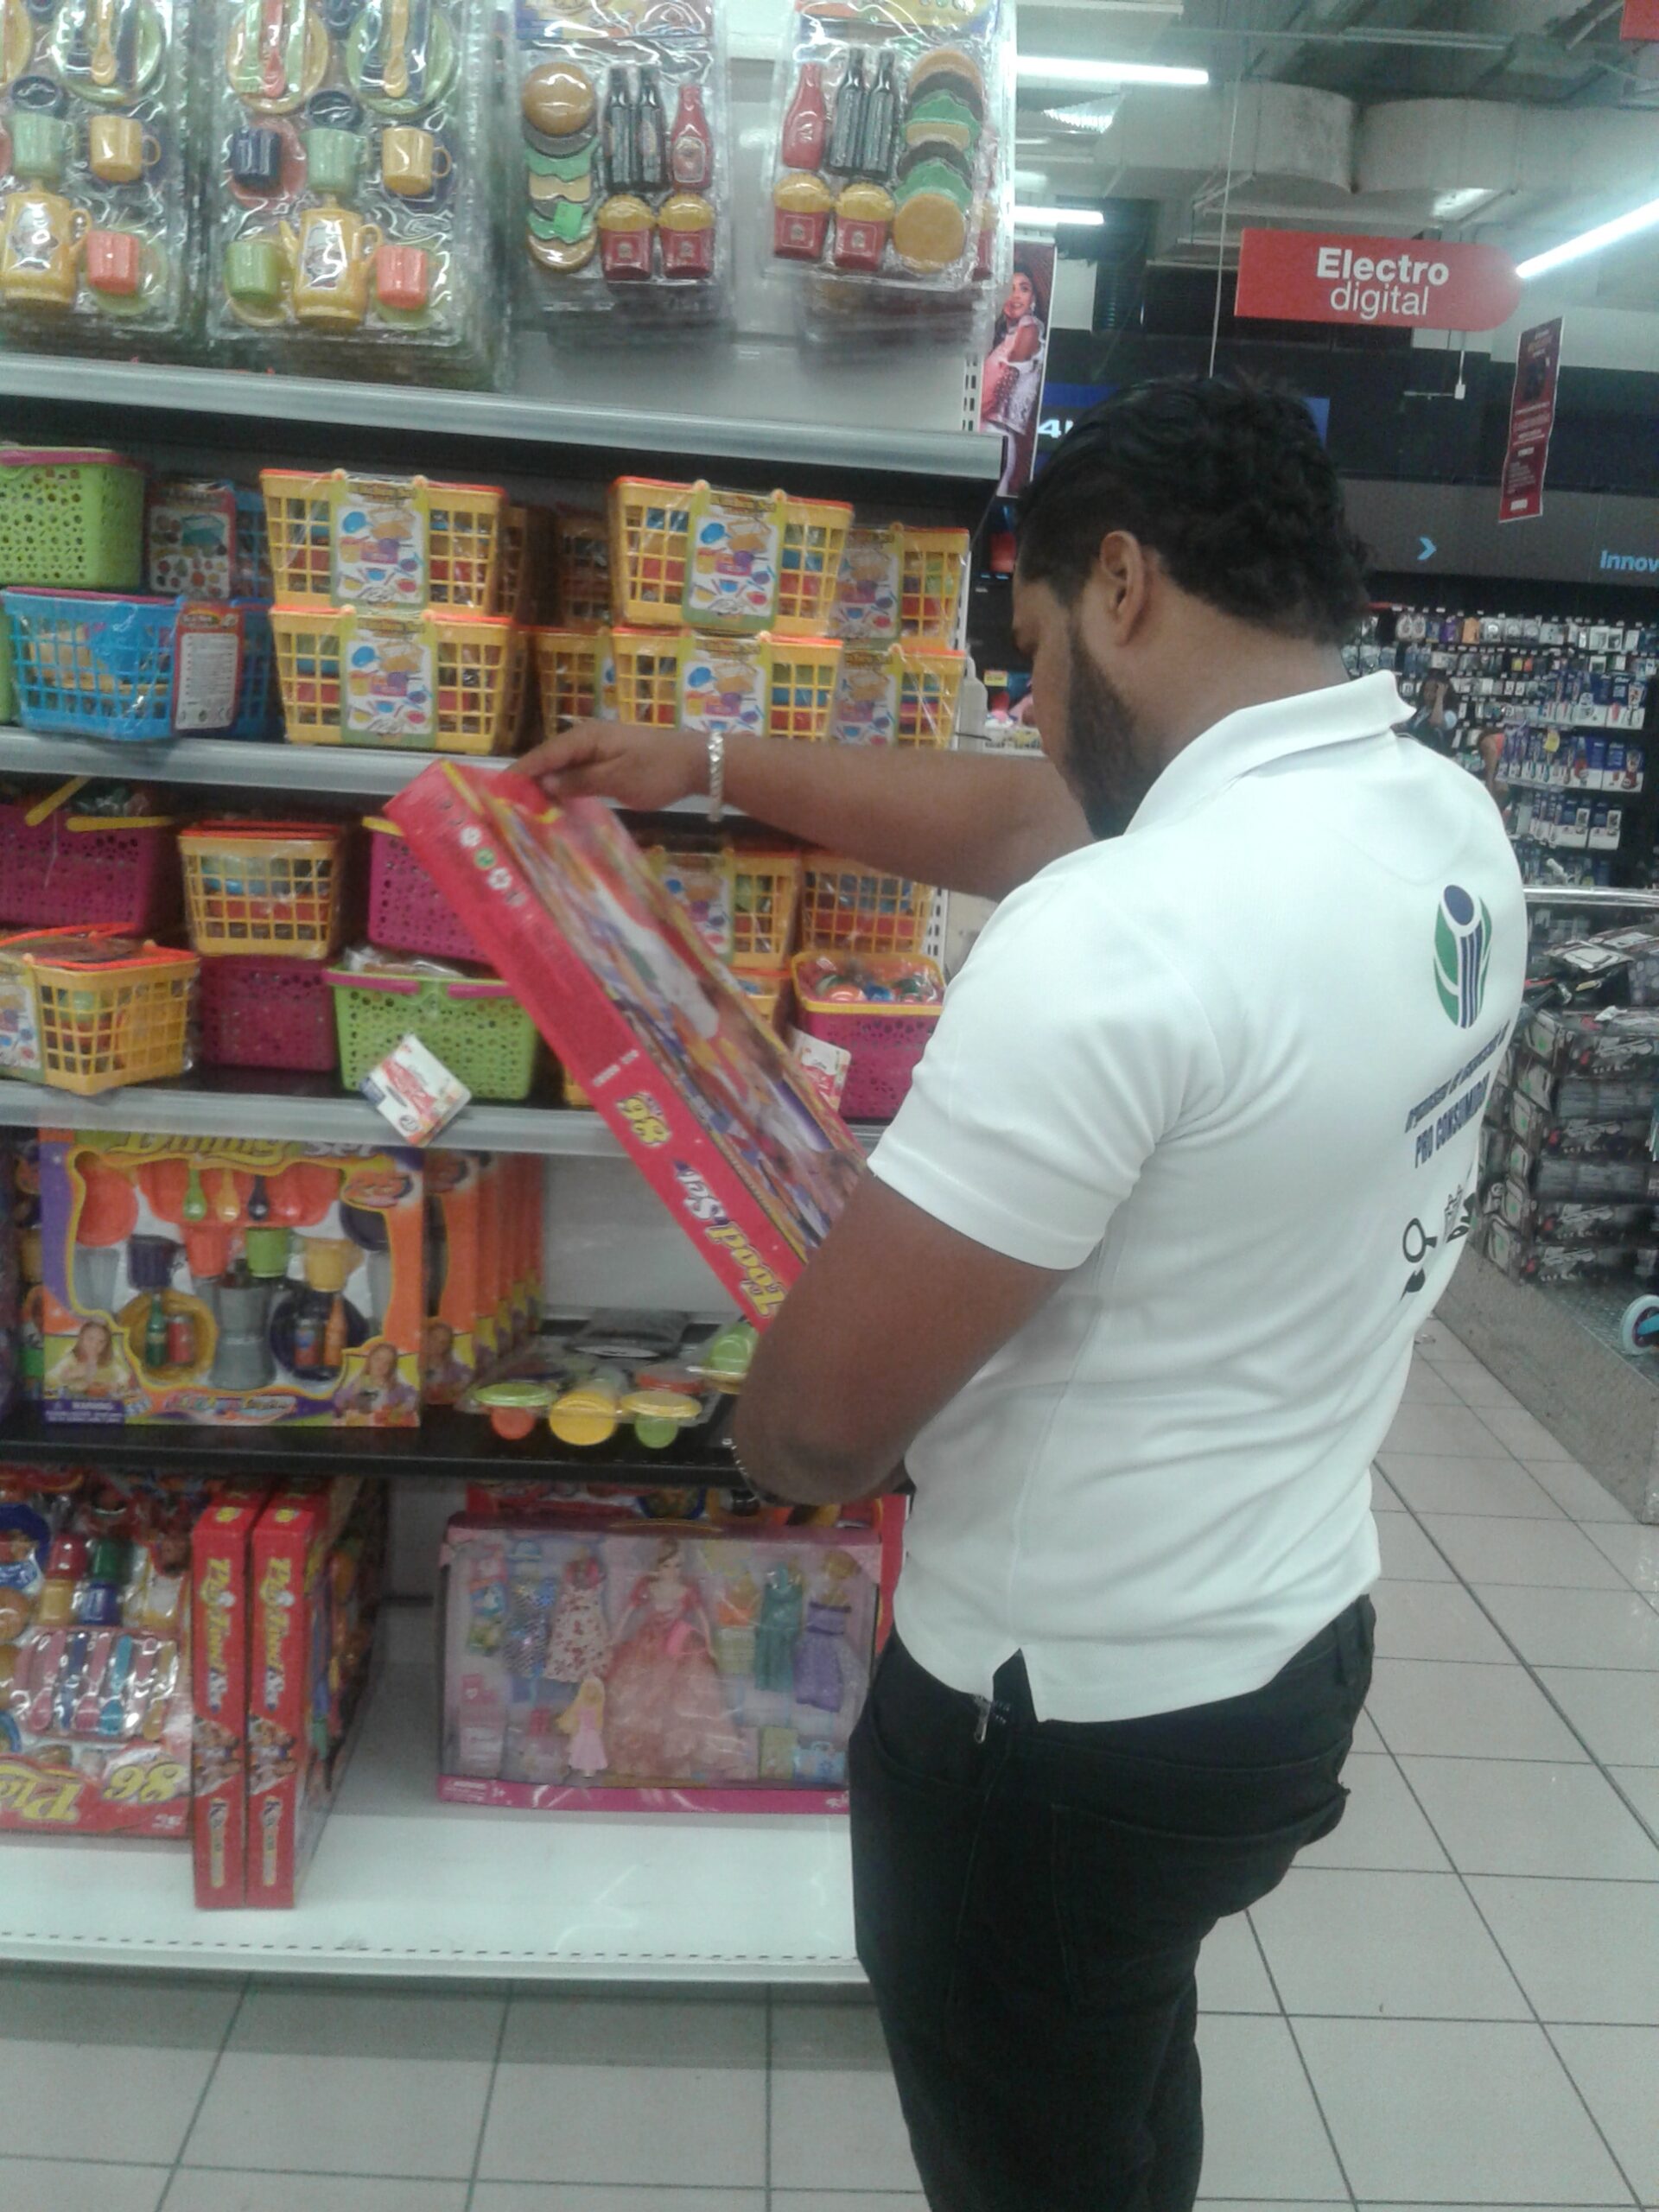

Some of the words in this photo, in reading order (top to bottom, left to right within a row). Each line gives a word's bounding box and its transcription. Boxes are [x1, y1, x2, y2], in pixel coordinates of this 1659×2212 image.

[1317, 247, 1449, 286] Electro
[1331, 280, 1429, 321] digital
[1600, 550, 1659, 572] Innov
[615, 1095, 671, 1147] 86
[675, 1167, 728, 1221] Set
[704, 1220, 787, 1318] Food
[0, 1764, 80, 1823] Pla
